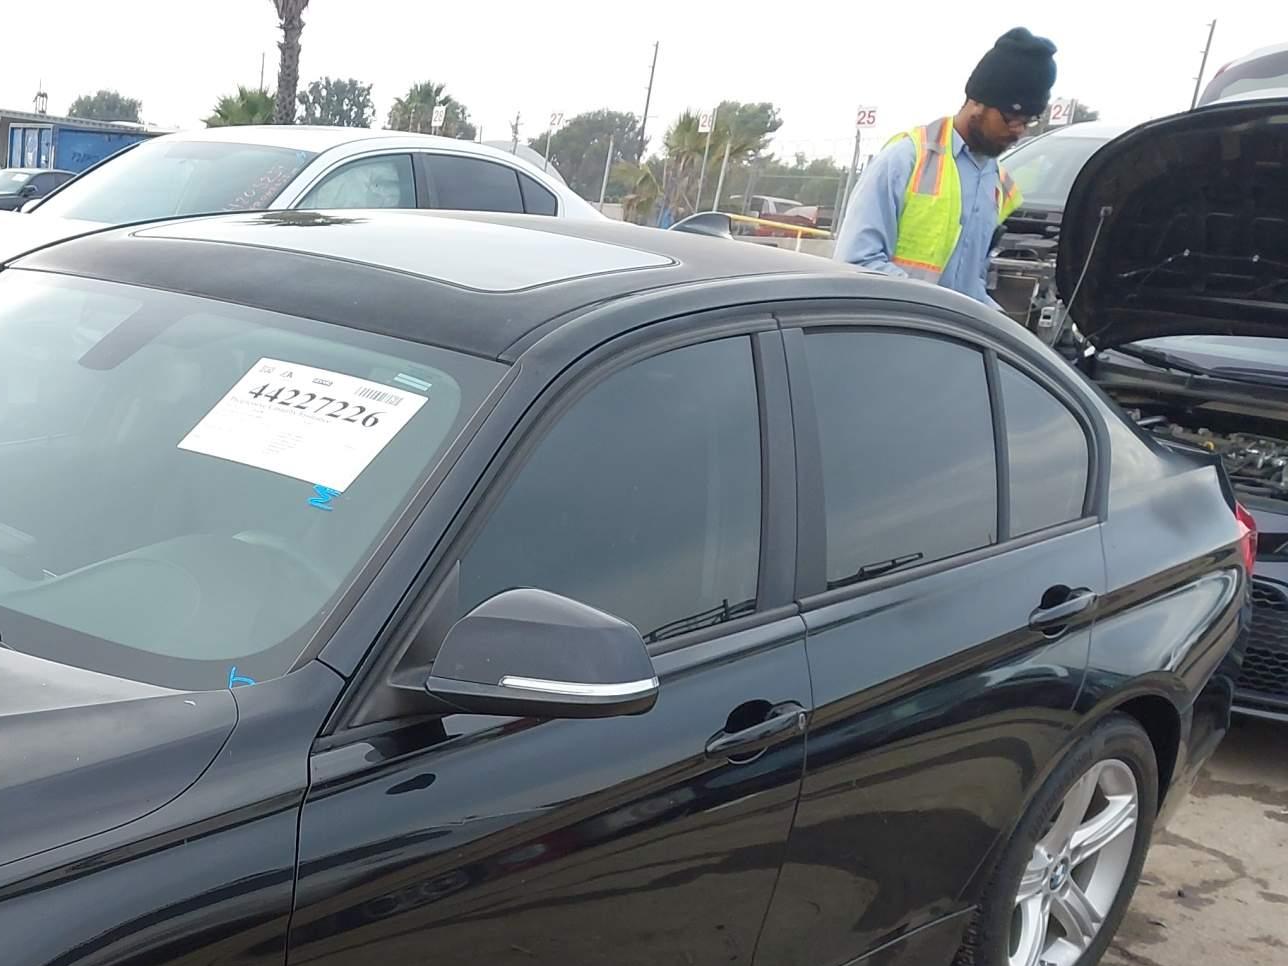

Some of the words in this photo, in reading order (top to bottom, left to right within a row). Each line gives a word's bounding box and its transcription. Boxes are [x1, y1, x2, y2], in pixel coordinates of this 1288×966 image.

[550, 112, 563, 126] 27
[856, 110, 877, 125] 25
[1052, 104, 1072, 120] 24
[248, 383, 387, 428] 44227226
